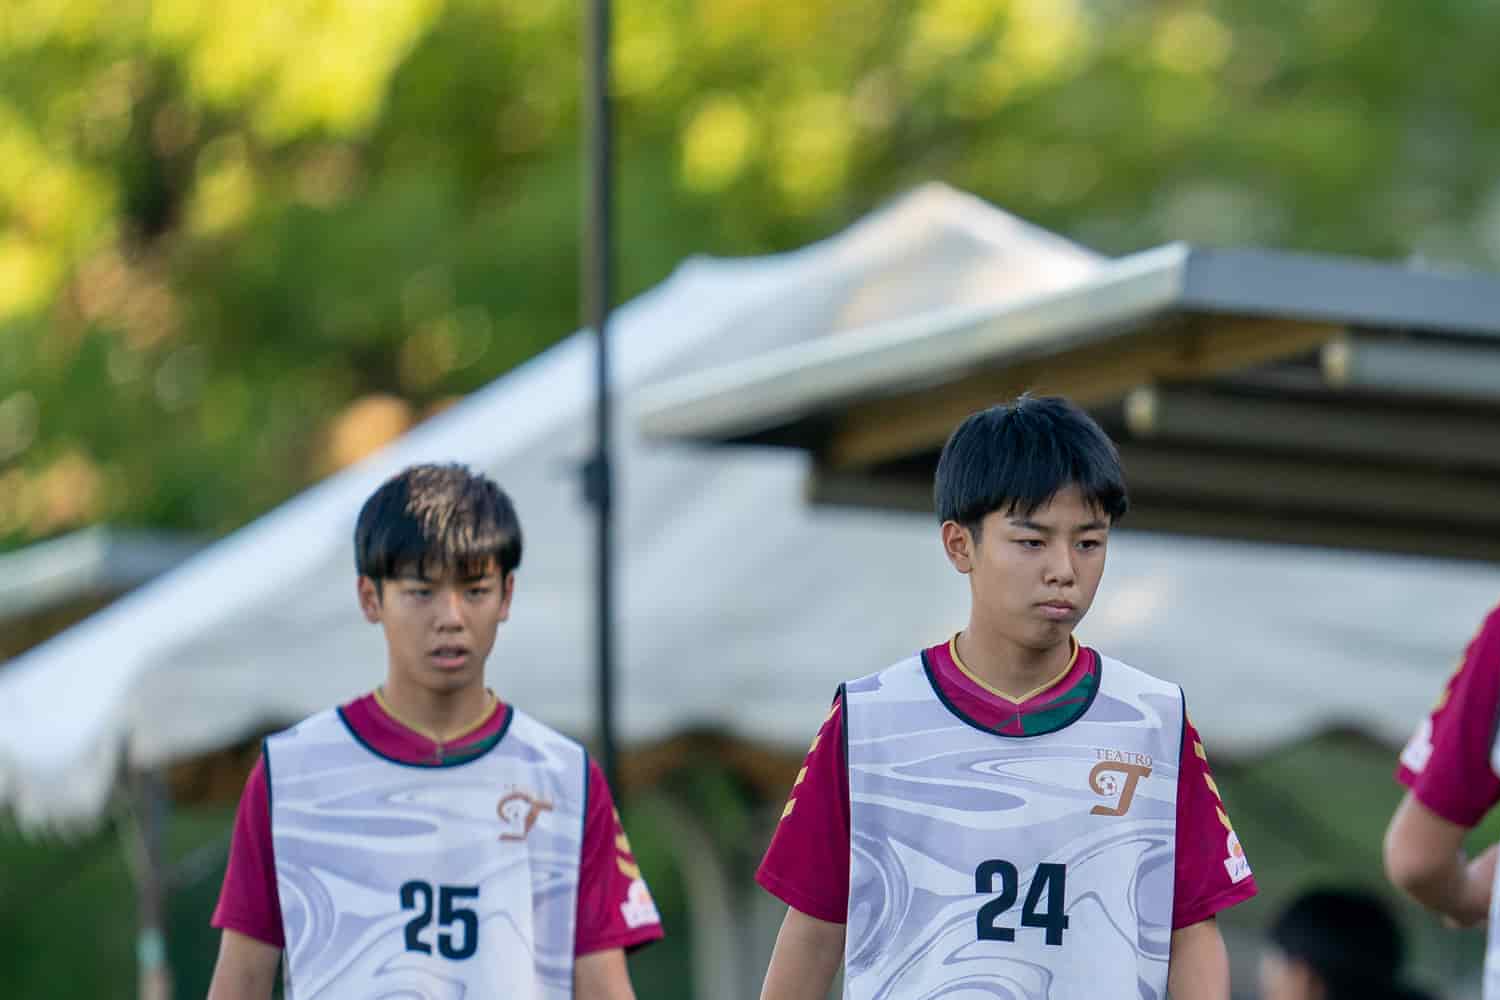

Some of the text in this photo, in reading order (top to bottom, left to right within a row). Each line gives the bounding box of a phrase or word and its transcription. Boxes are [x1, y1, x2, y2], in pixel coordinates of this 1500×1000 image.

[1095, 747, 1153, 767] TEATRO
[399, 881, 480, 961] 25
[974, 859, 1069, 946] 24
